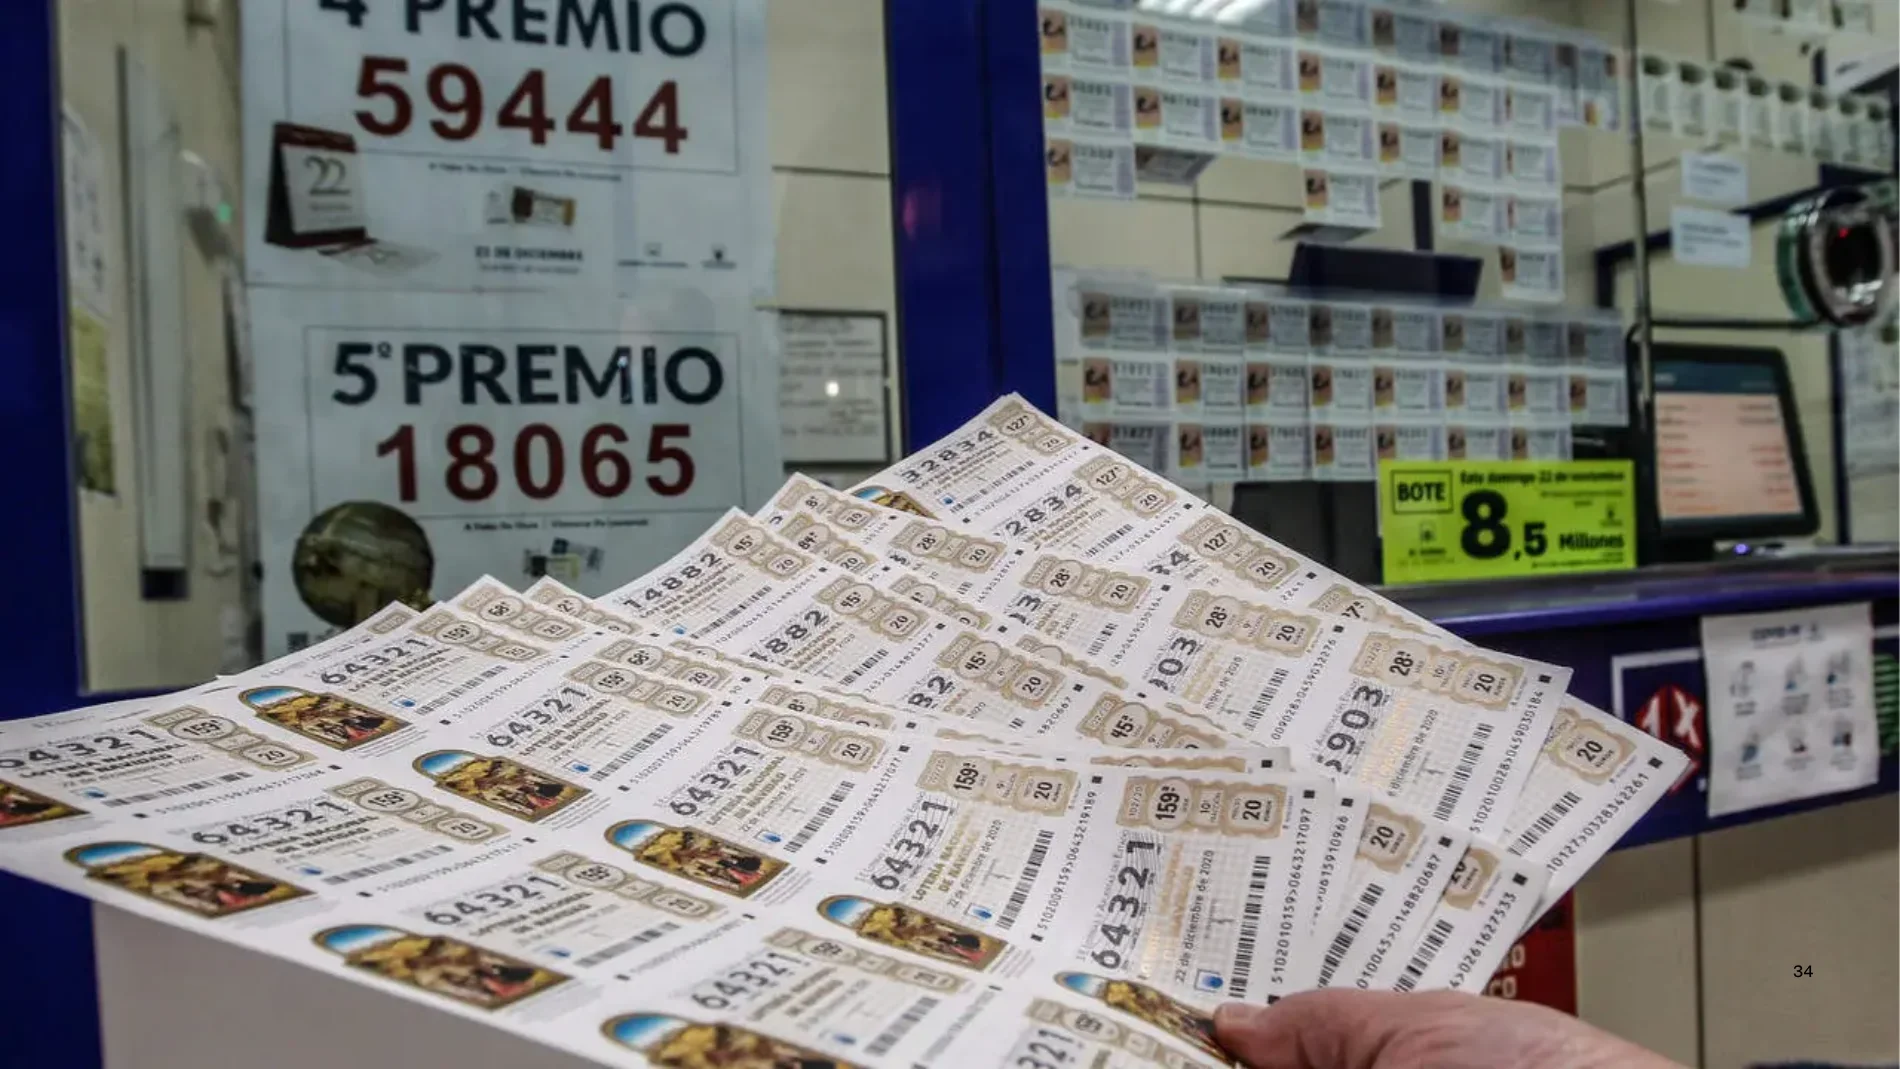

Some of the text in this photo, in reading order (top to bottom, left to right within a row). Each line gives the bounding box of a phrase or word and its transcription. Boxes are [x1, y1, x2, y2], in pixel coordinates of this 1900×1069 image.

[404, 0, 706, 58] PREMIO
[354, 55, 688, 154] 59444
[303, 155, 351, 196] 22
[403, 343, 723, 406] PREMIO
[377, 423, 696, 502] 18065
[901, 430, 994, 484] 32834
[1140, 494, 1158, 507] 20
[1397, 483, 1445, 501] BOTE
[969, 549, 987, 562] 20
[1559, 533, 1624, 551] Millones
[623, 552, 722, 611] 14882
[1256, 561, 1276, 577] 20
[1110, 584, 1129, 600] 20
[890, 615, 909, 629] 20
[1275, 624, 1296, 642] 20
[321, 638, 429, 685] 64321
[1022, 676, 1042, 693] 20
[1473, 674, 1495, 693] 20
[486, 686, 587, 748] 64321
[843, 743, 861, 758] 20
[1577, 740, 1603, 762] 20
[670, 746, 761, 817] 64321
[1034, 781, 1053, 801] 20
[191, 800, 353, 845] 64321
[1242, 799, 1262, 821] 20
[871, 800, 955, 890] 64321
[1370, 825, 1395, 850] 20
[423, 875, 562, 927] 64321
[1091, 840, 1155, 970] 64321
[1182, 894, 1205, 951] diciembre
[691, 951, 803, 1010] 64321
